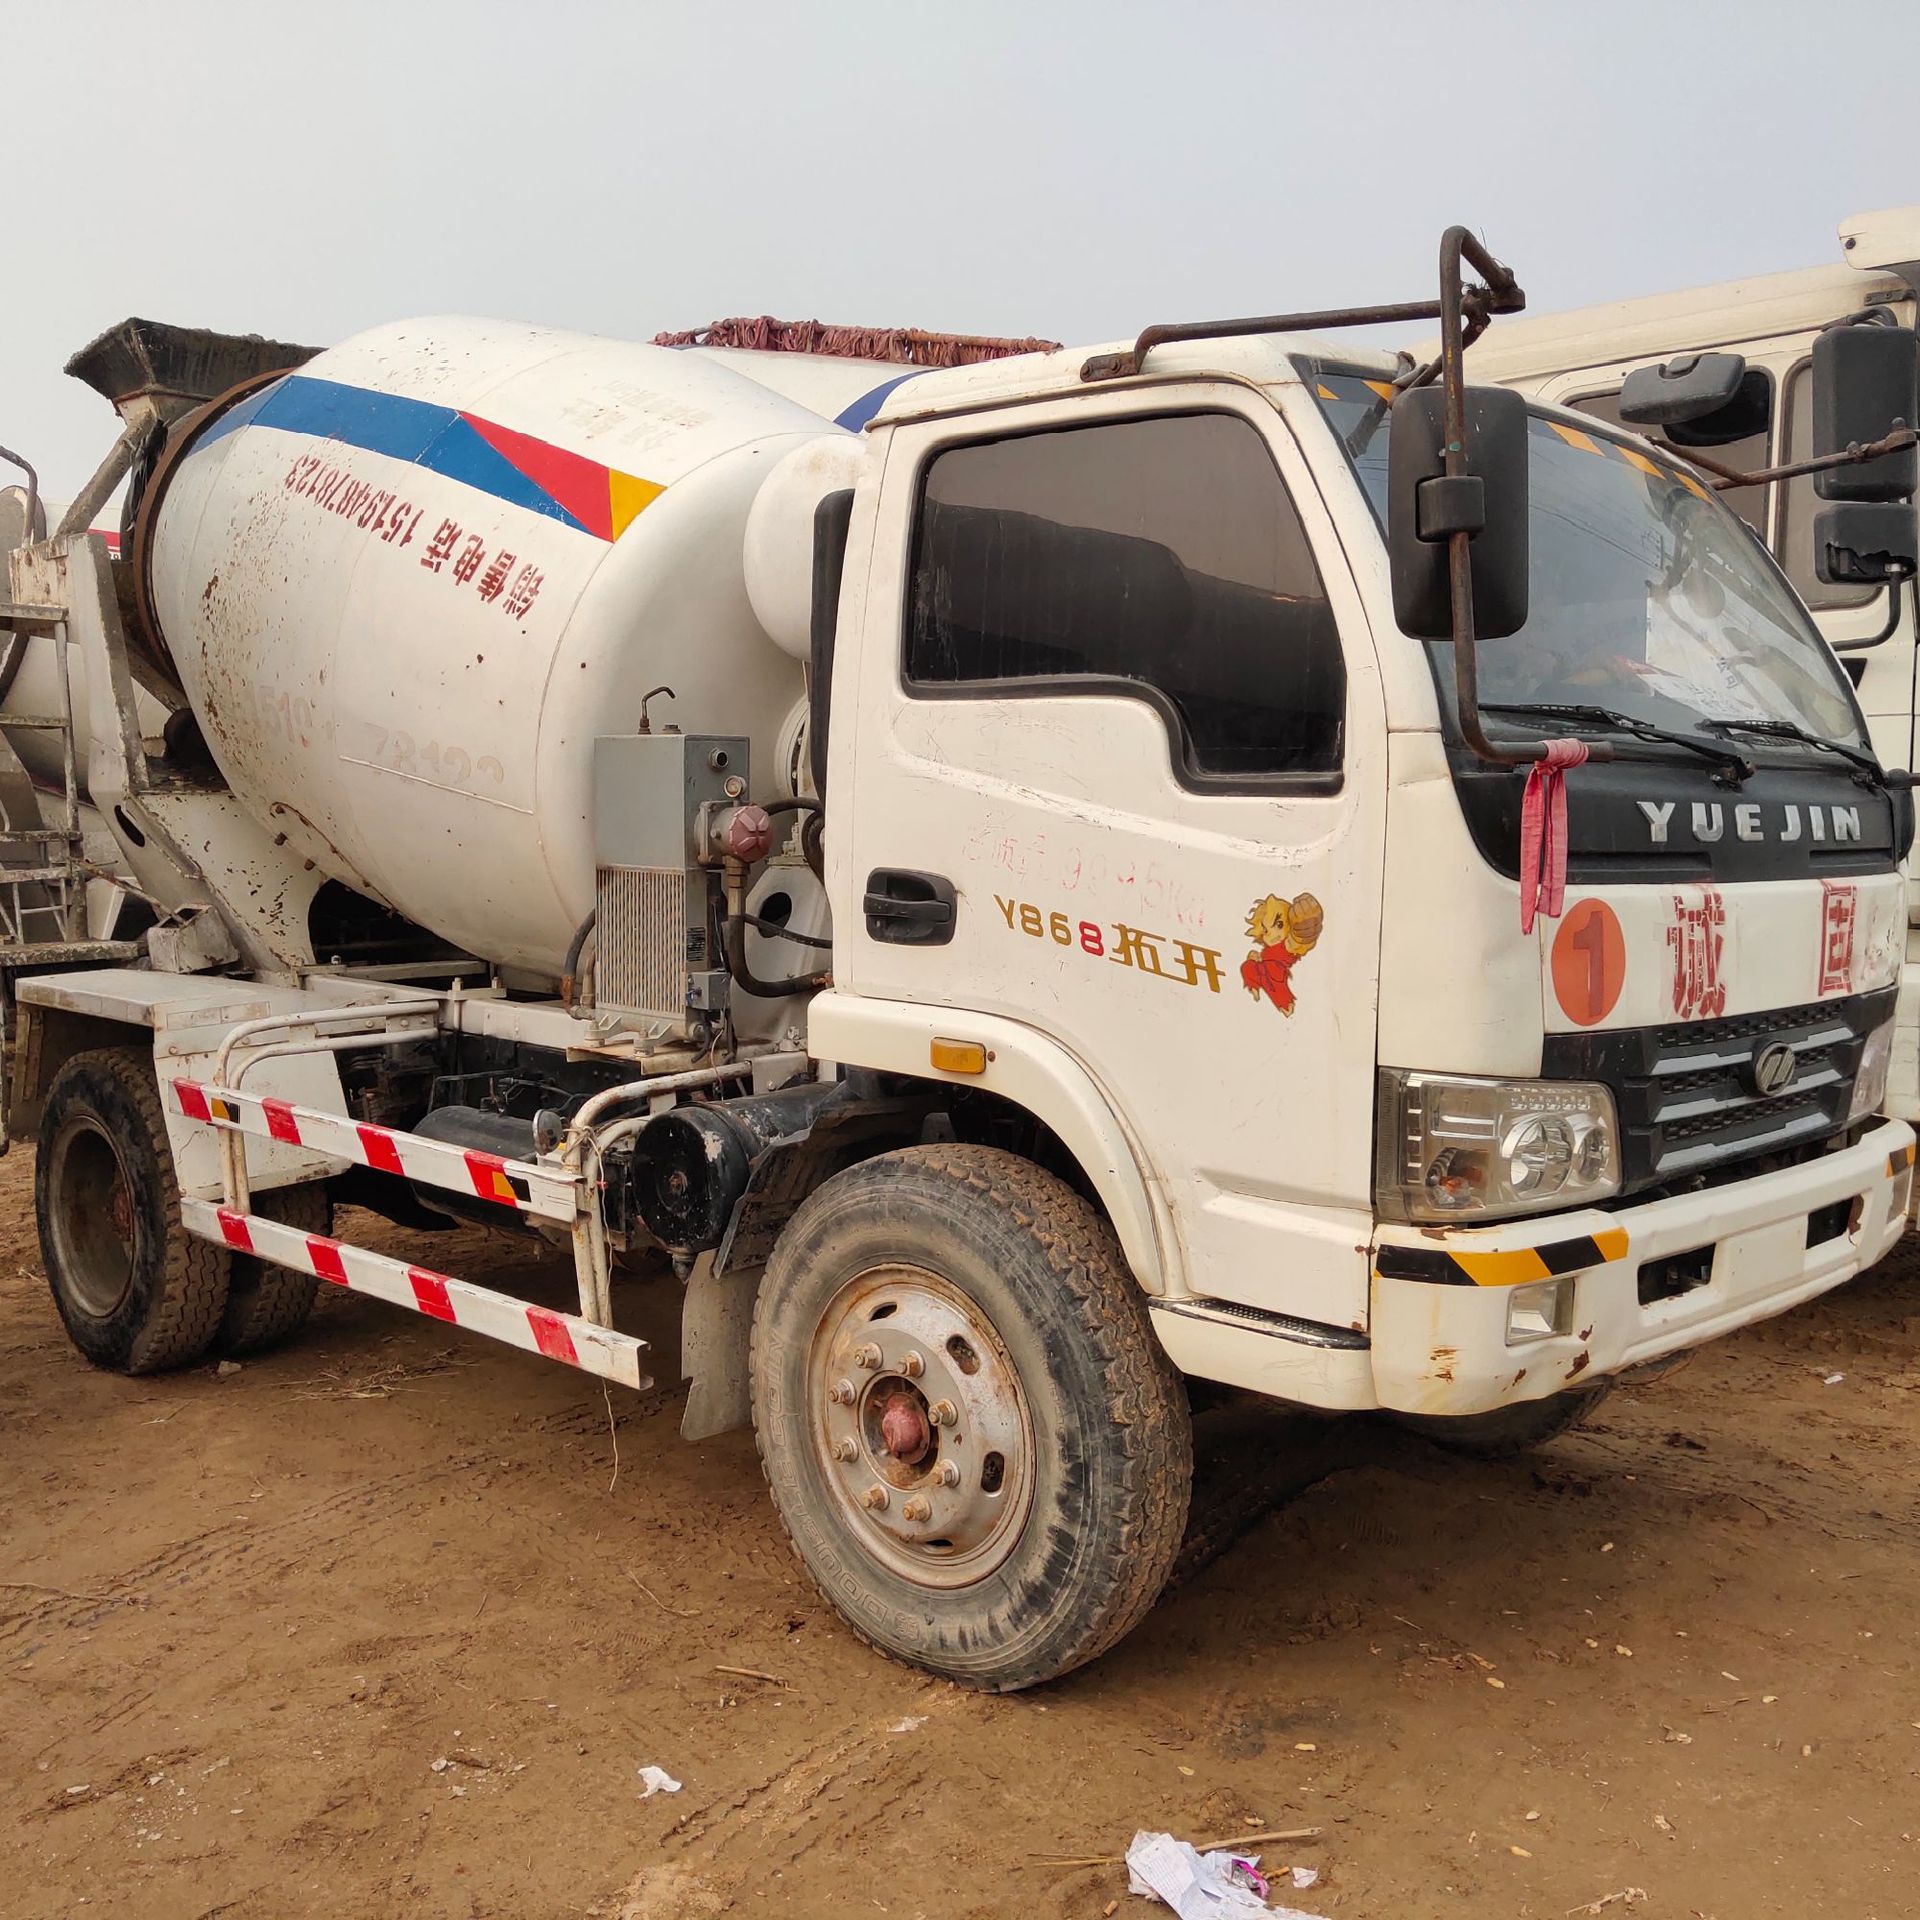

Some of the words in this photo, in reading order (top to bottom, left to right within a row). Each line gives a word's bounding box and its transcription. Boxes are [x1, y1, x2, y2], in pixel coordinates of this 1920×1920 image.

[419, 520, 544, 619] 销售电话
[1636, 801, 1862, 844] YUEJIN
